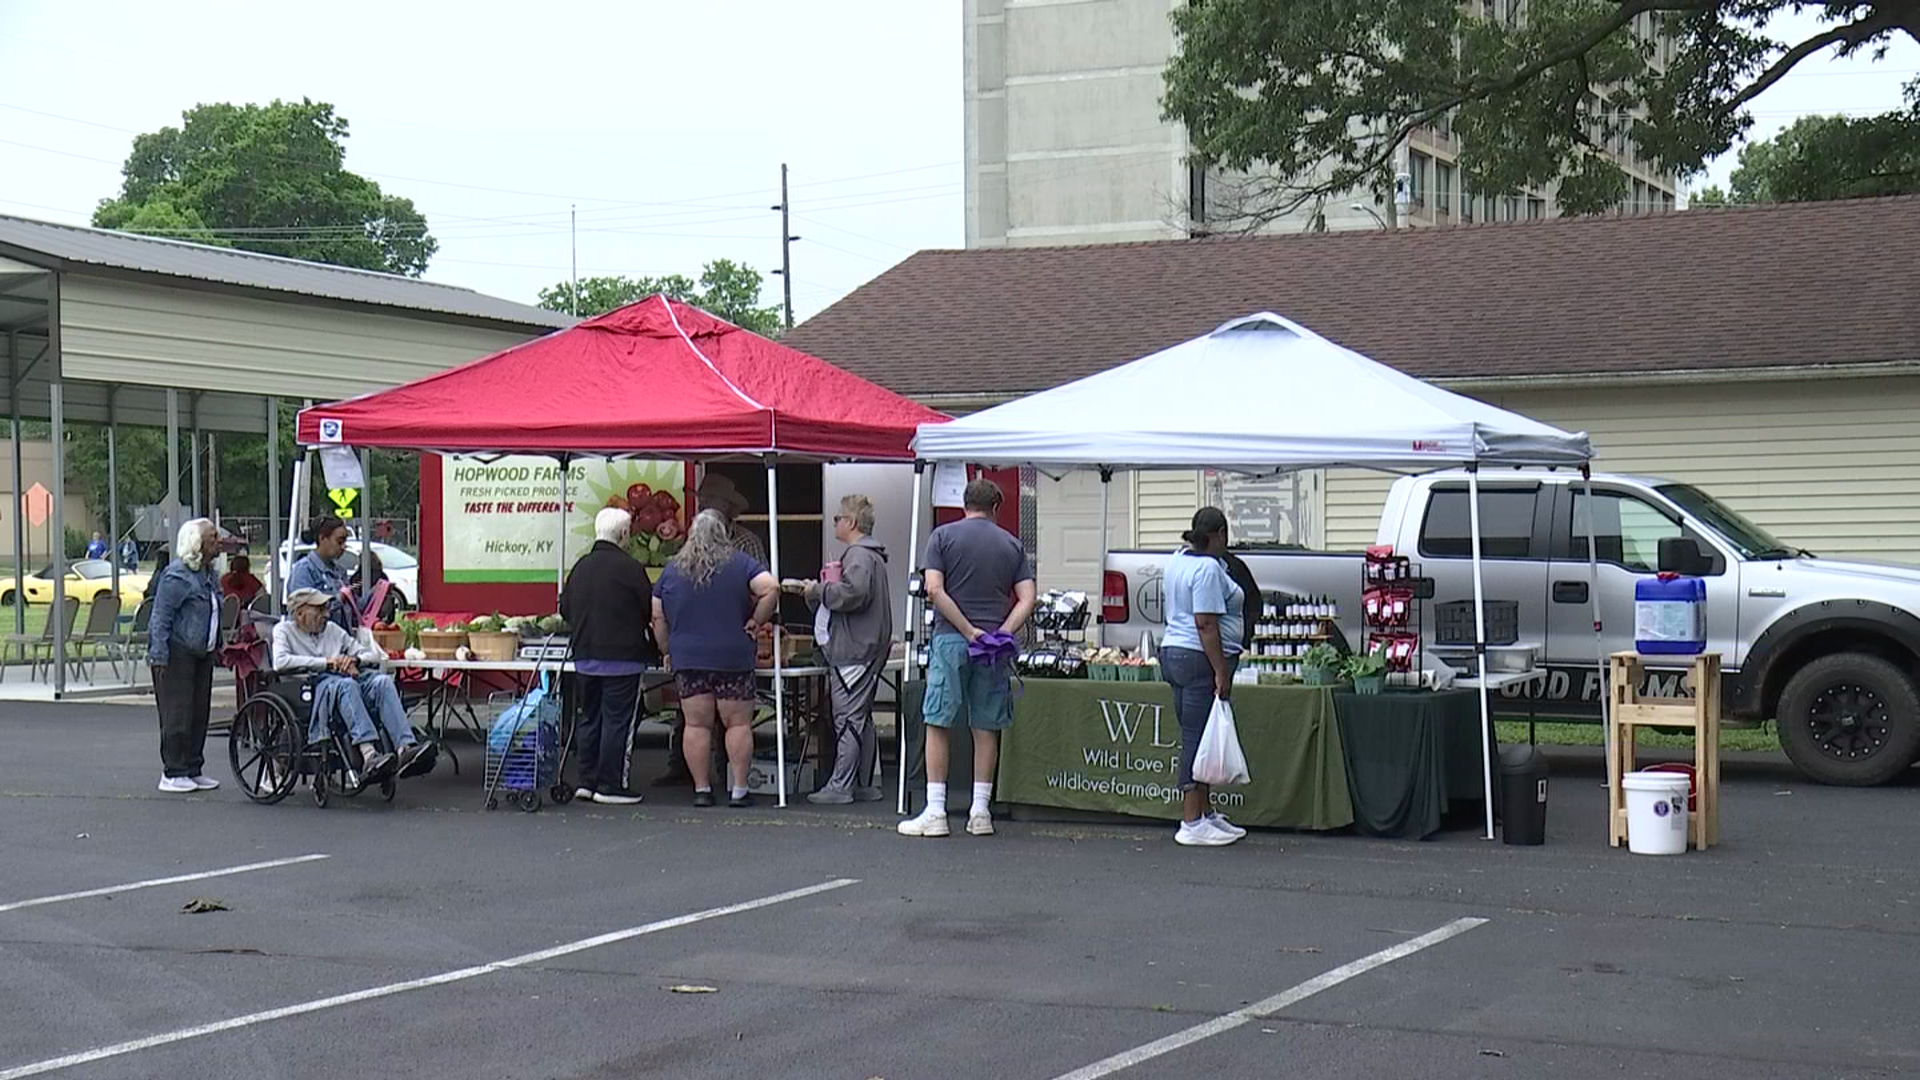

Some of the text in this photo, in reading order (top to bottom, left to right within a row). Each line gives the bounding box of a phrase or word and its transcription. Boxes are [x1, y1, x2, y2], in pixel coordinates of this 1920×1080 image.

[454, 467, 529, 481] HOPWOOD
[460, 486, 491, 497] FRESH
[532, 486, 578, 498] PRODCE
[464, 502, 493, 513] TASTE
[496, 502, 513, 513] THE
[485, 541, 553, 555] Hickory, KY
[1097, 700, 1182, 749] WL
[1083, 747, 1119, 769] Wild
[1126, 754, 1164, 774] Love
[1046, 772, 1244, 806] wildlovefarm@gmcom
